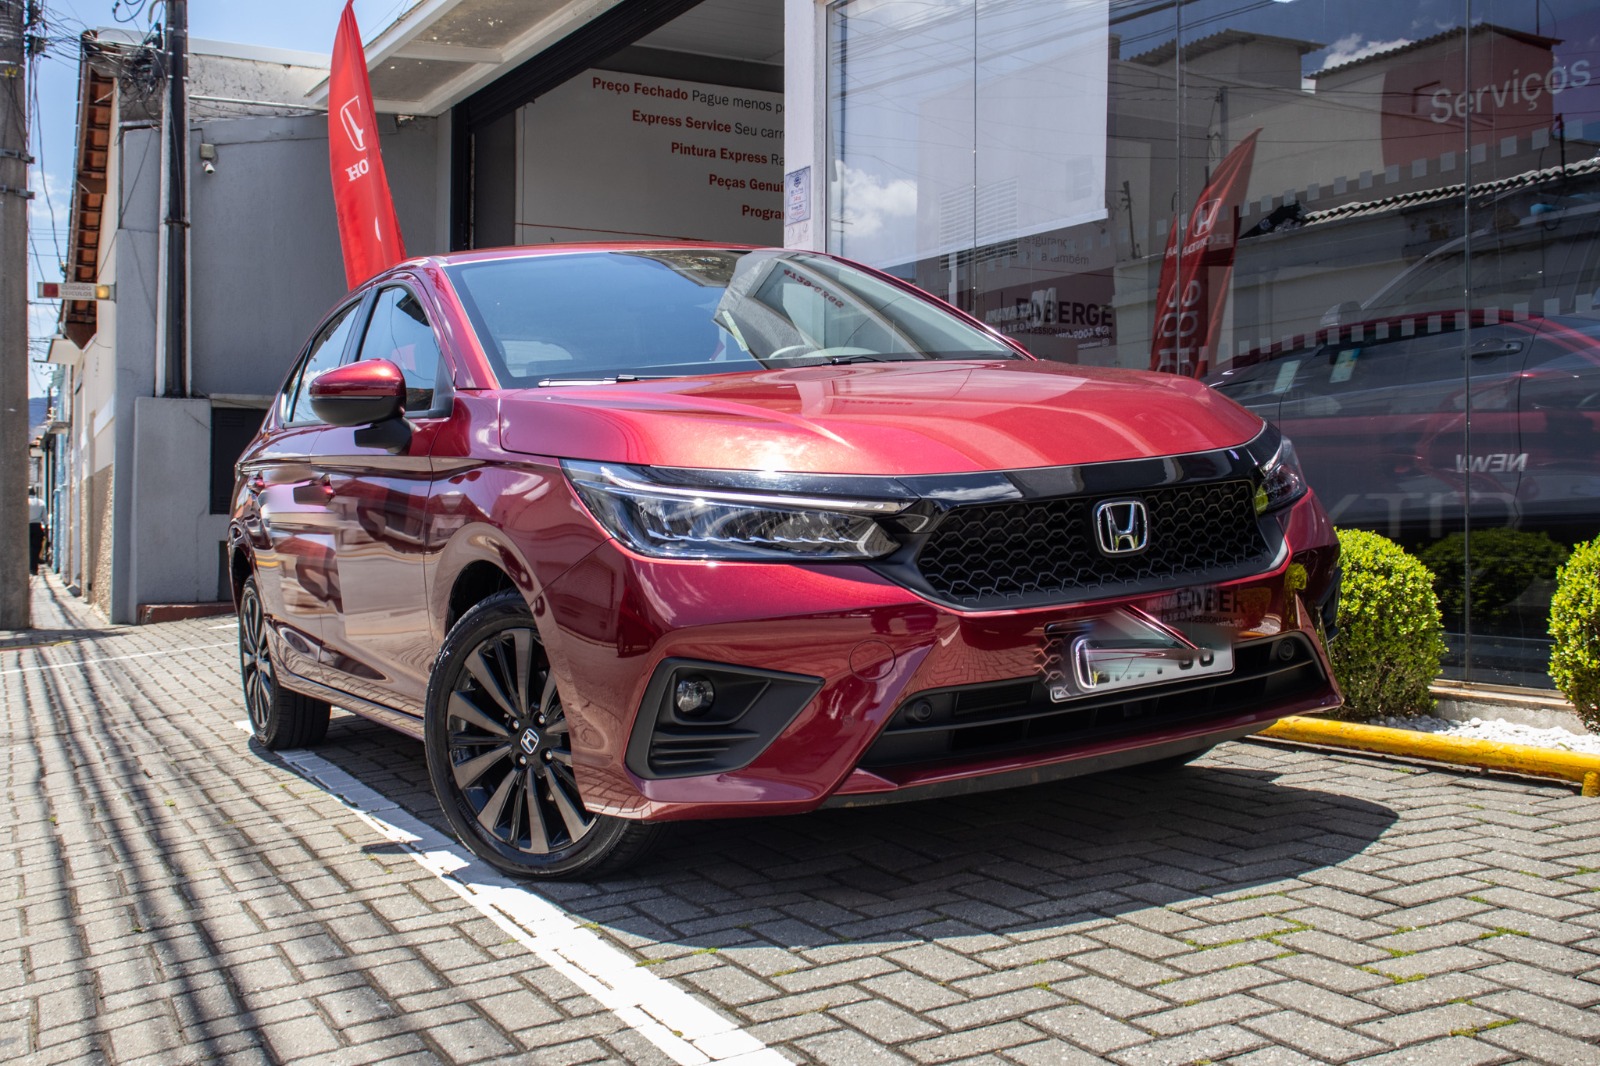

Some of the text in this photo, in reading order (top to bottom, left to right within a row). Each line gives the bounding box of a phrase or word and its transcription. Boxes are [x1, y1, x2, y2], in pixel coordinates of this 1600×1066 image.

[592, 77, 630, 95] Preço
[634, 82, 688, 100] Fechado
[692, 89, 729, 107] Pague
[733, 97, 772, 112] menos
[1430, 59, 1591, 123] Serviços
[632, 110, 682, 127] Express
[686, 116, 731, 133] Service
[735, 122, 757, 136] Seu
[671, 142, 716, 158] Pintura
[720, 148, 768, 164] Express
[709, 174, 746, 190] Peças
[742, 205, 784, 221] Progra
